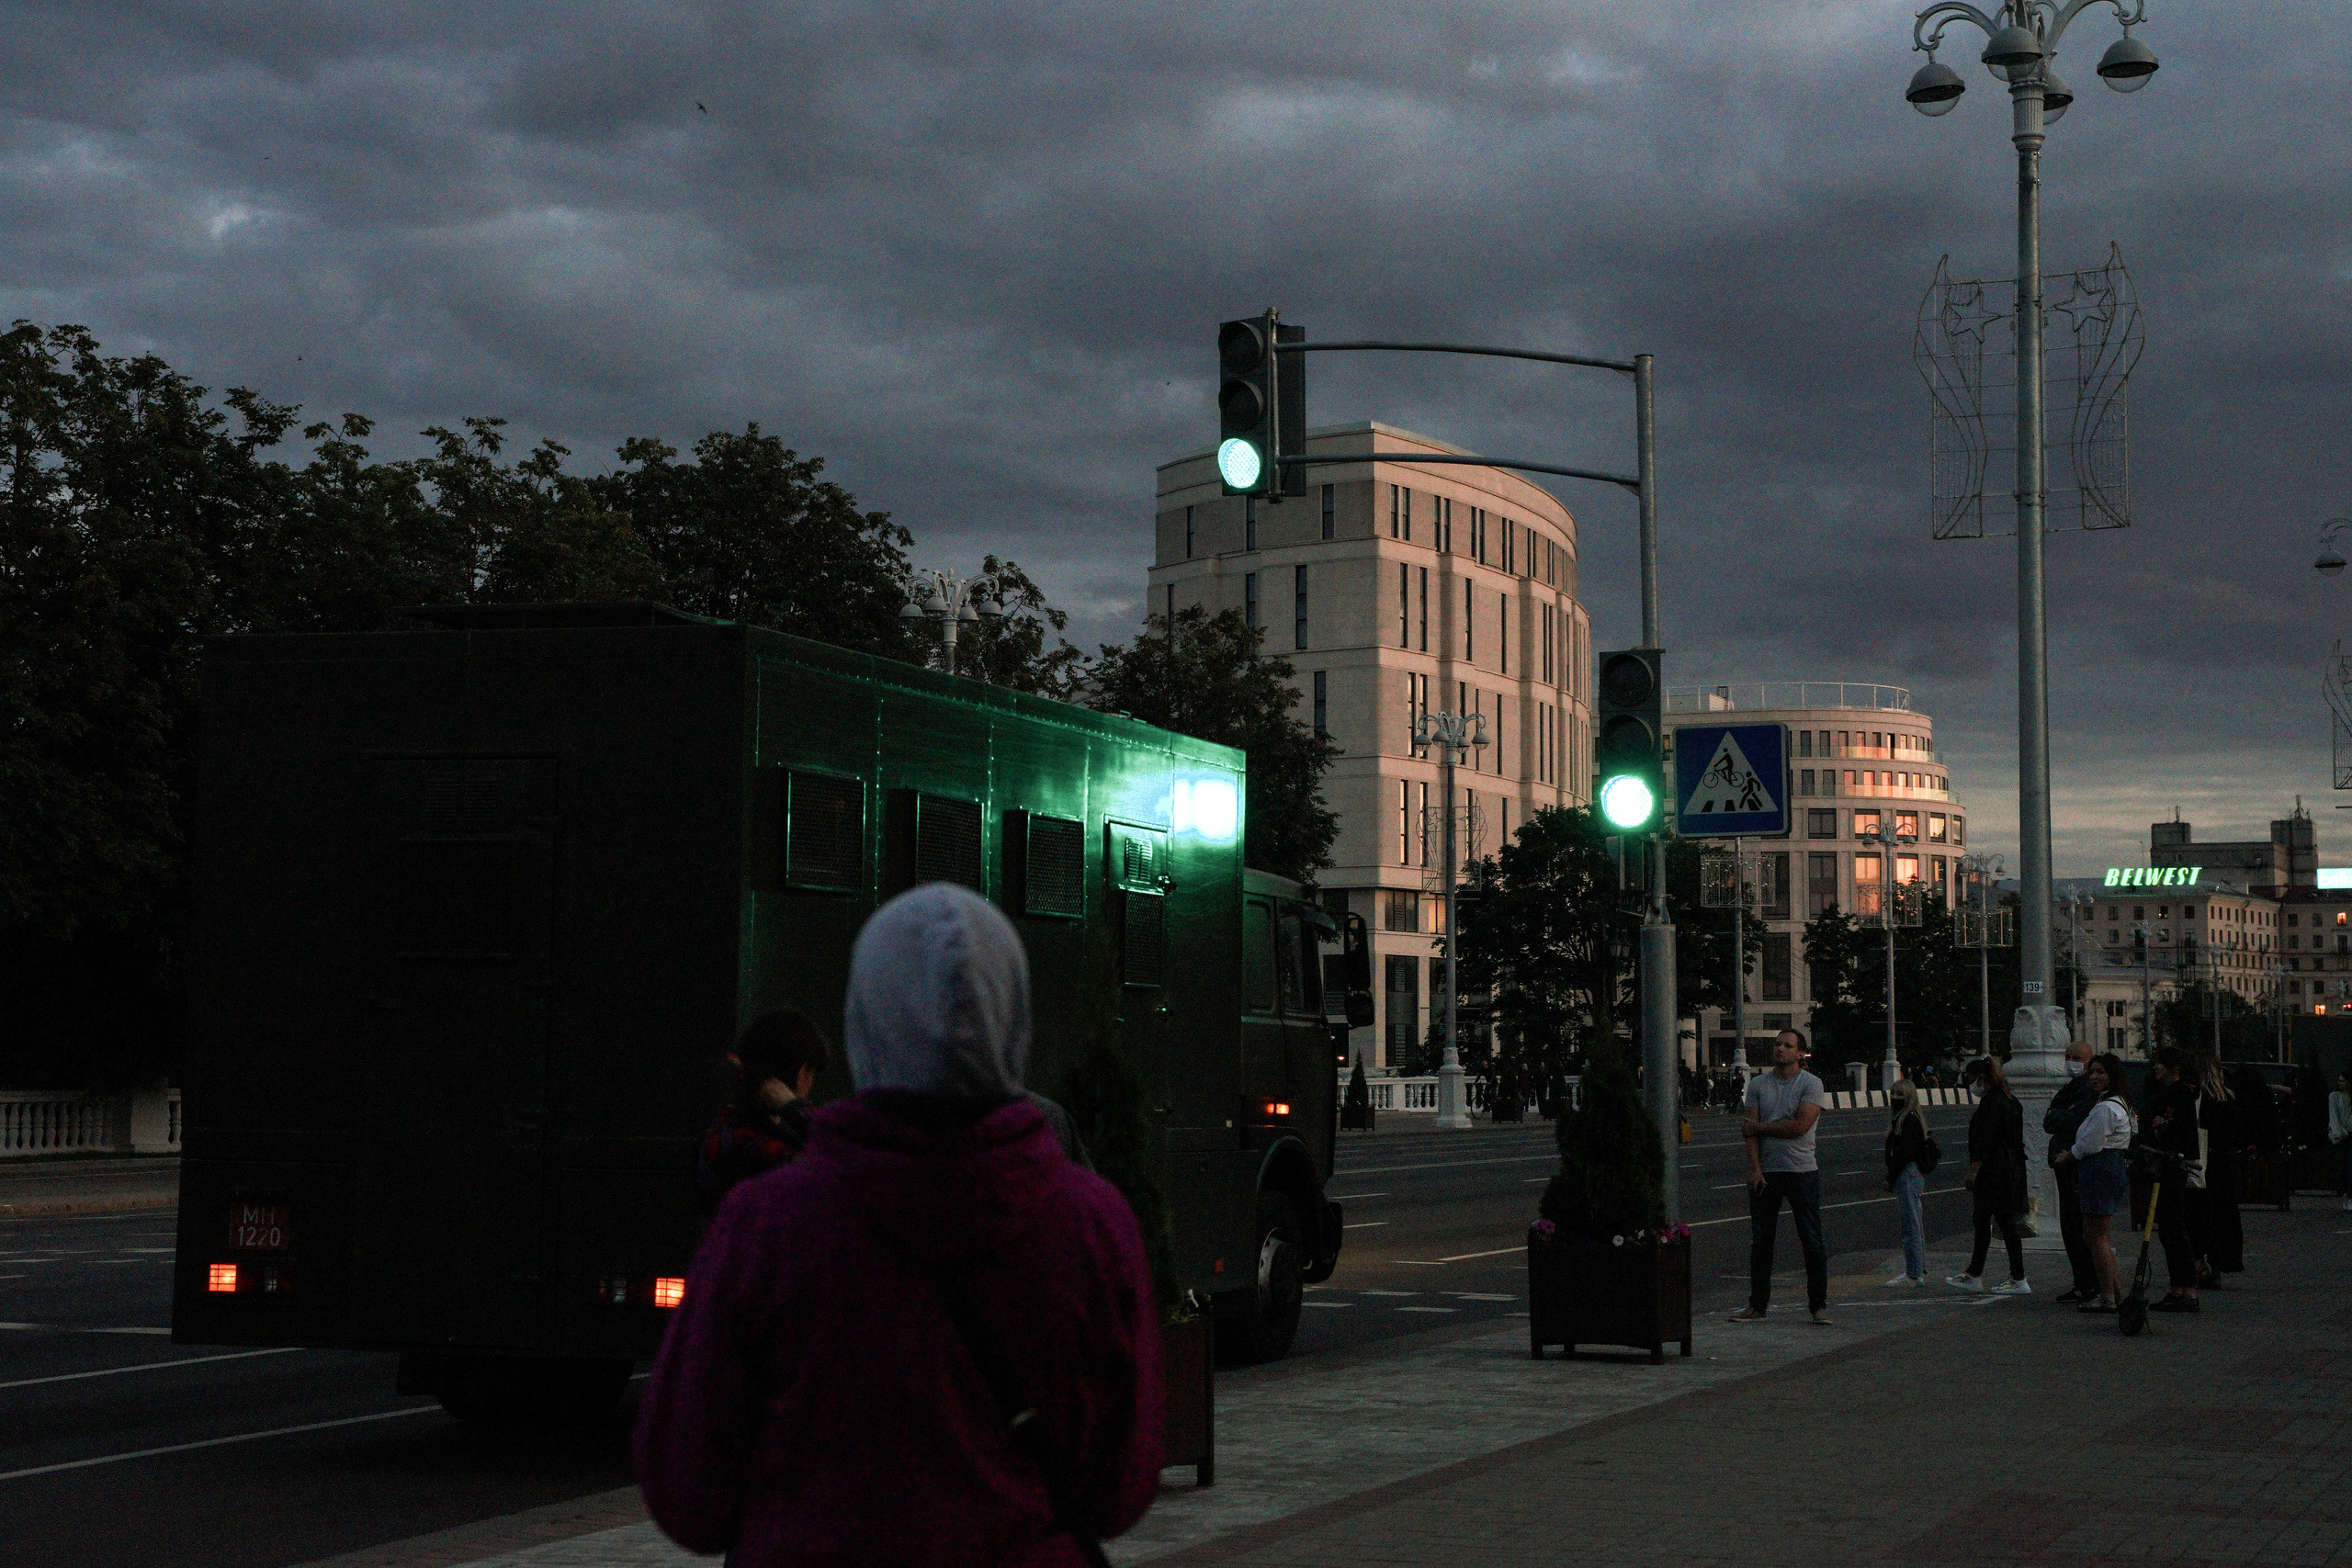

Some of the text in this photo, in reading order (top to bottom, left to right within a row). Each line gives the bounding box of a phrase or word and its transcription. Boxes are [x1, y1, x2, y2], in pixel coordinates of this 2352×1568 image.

[2104, 866, 2203, 887] BELWEST
[2025, 982, 2040, 992] 139
[237, 1225, 281, 1247] 1220
